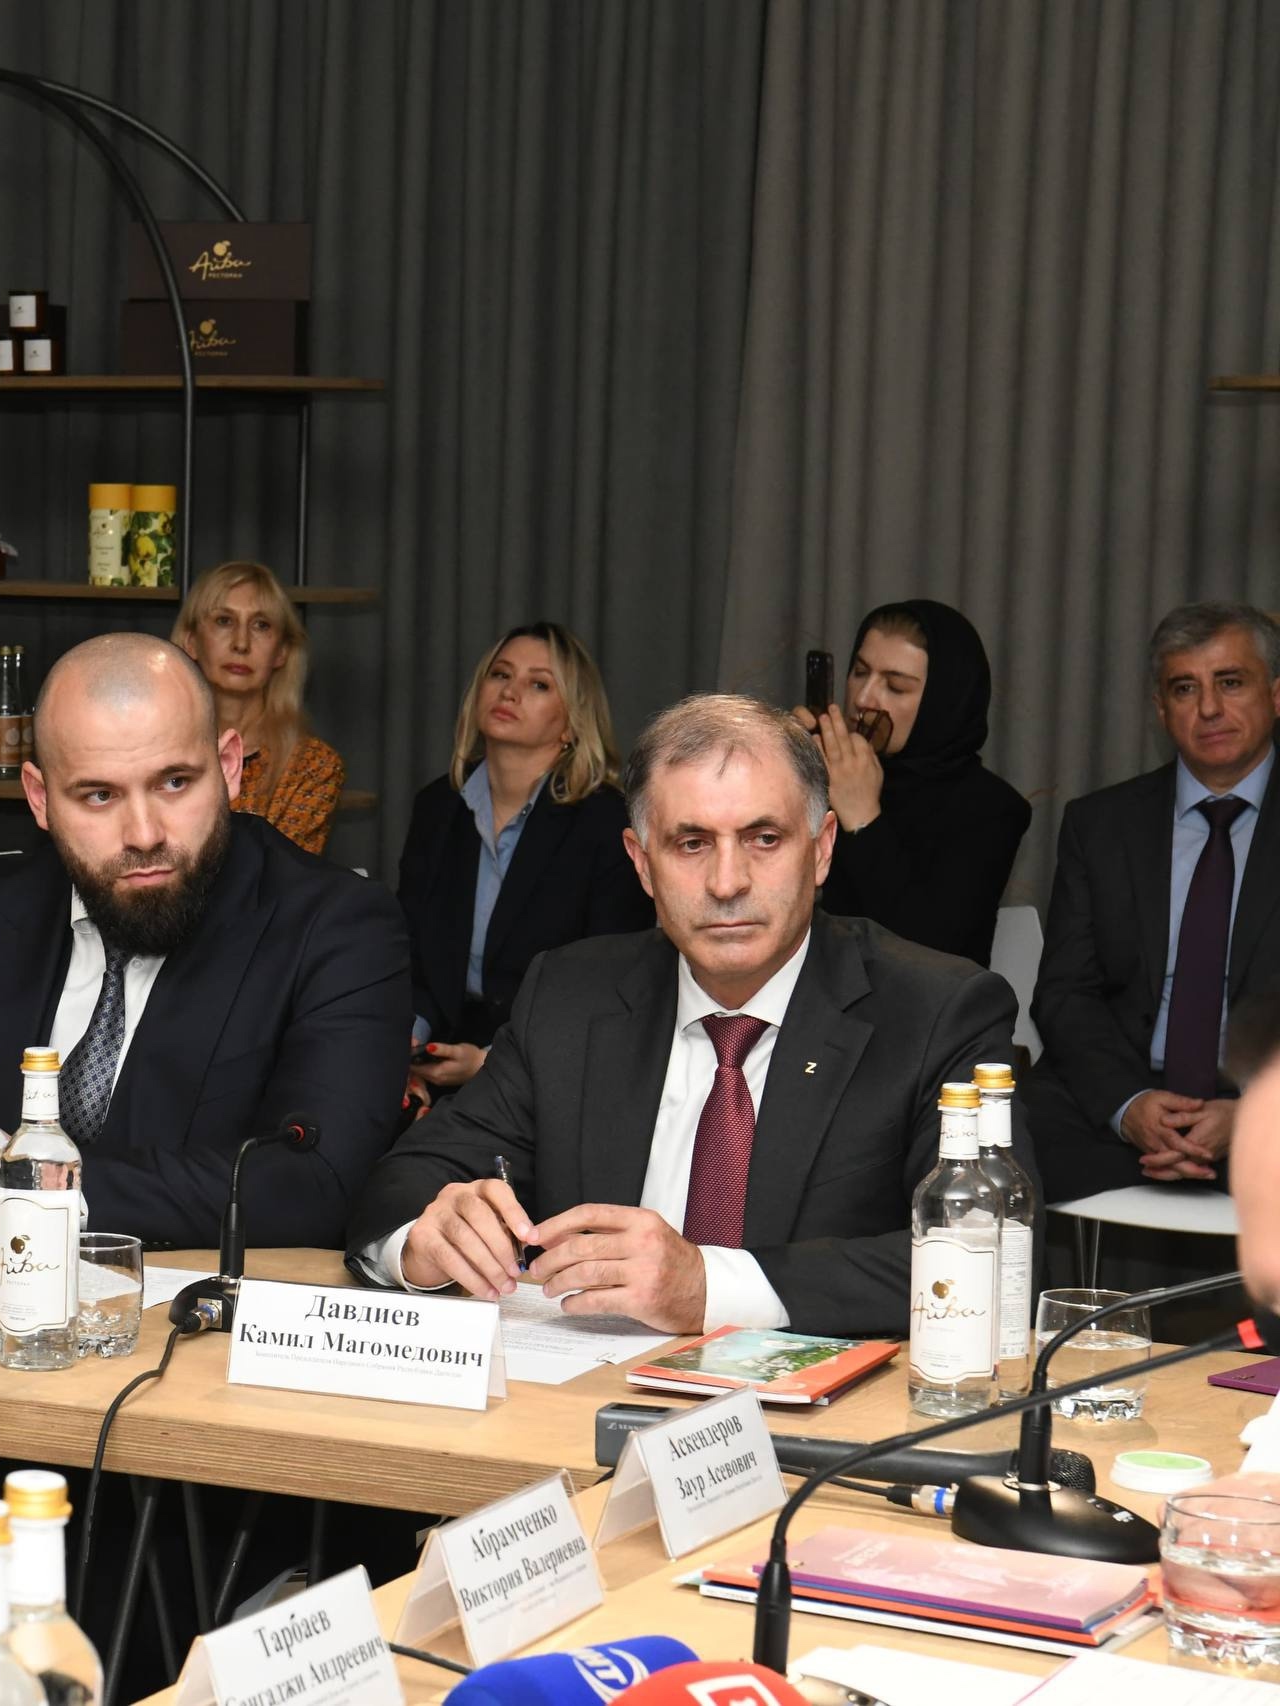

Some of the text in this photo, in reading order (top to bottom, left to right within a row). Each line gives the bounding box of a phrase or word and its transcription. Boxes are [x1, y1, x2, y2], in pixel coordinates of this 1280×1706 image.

[189, 251, 251, 280] Айва
[805, 1061, 817, 1074] Z
[304, 1294, 421, 1327] Давдиев
[911, 1292, 987, 1333] Айва
[239, 1322, 483, 1367] Камил Магомедович
[668, 1415, 743, 1462] Аскендеров
[674, 1473, 706, 1501] Заур
[706, 1450, 758, 1488] Асевович
[470, 1504, 558, 1562] Абрамченко
[459, 1568, 524, 1612] Виктория
[521, 1535, 587, 1581] Валериевна
[254, 1609, 332, 1658] Тарбаев
[308, 1635, 386, 1684] Андреевич
